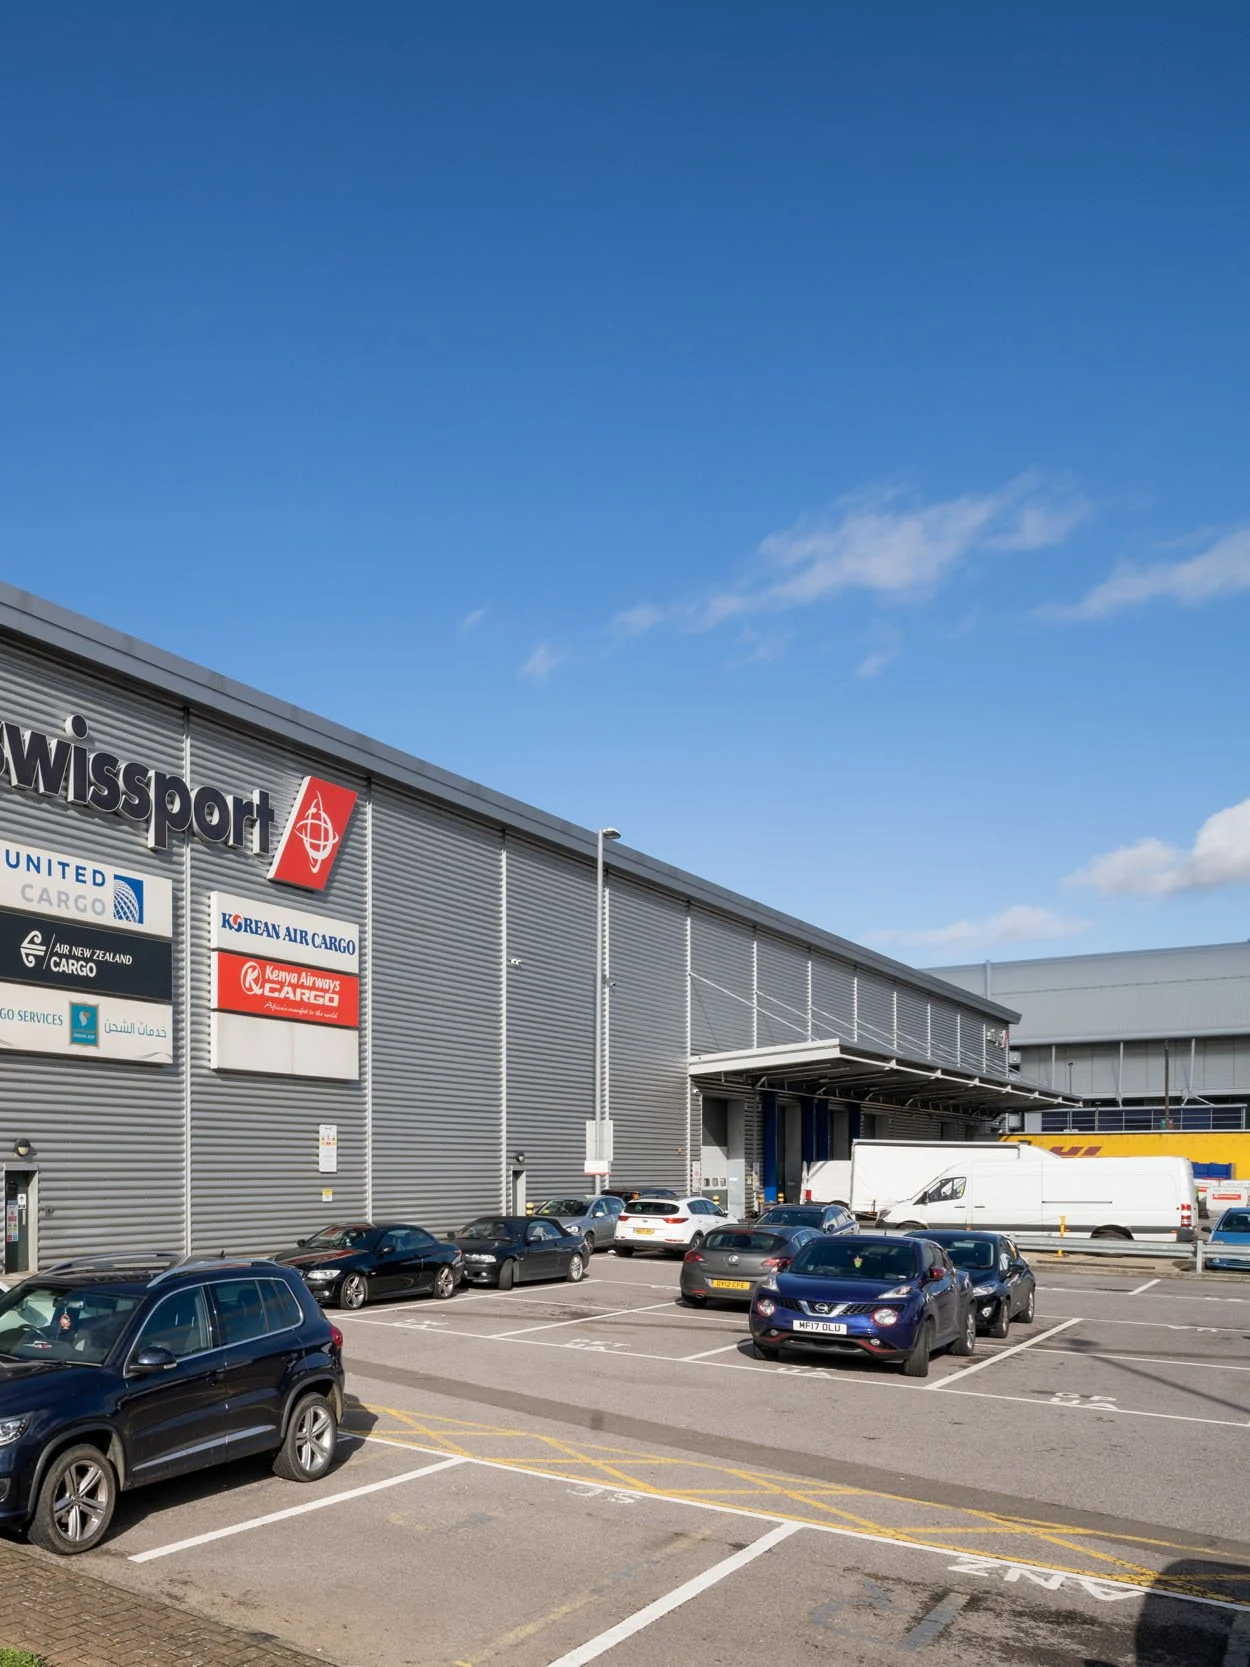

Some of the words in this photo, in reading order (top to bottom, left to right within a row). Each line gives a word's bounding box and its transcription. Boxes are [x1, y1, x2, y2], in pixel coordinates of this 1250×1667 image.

[5, 849, 106, 887] UNITED
[20, 883, 106, 916] CARGO
[221, 912, 281, 940] KOREAN
[283, 926, 310, 946] AIR
[311, 932, 356, 956] CARGO
[53, 942, 70, 955] AIR
[71, 946, 93, 958] NEW
[93, 949, 133, 965] ZEALAND
[50, 956, 97, 978] CARGO
[265, 965, 298, 986] Kenya
[299, 971, 341, 994] Airways
[263, 982, 339, 1007] CARGO
[17, 1009, 64, 1026] SERVICES
[799, 1322, 819, 1332] MF17
[822, 1323, 841, 1332] OLU
